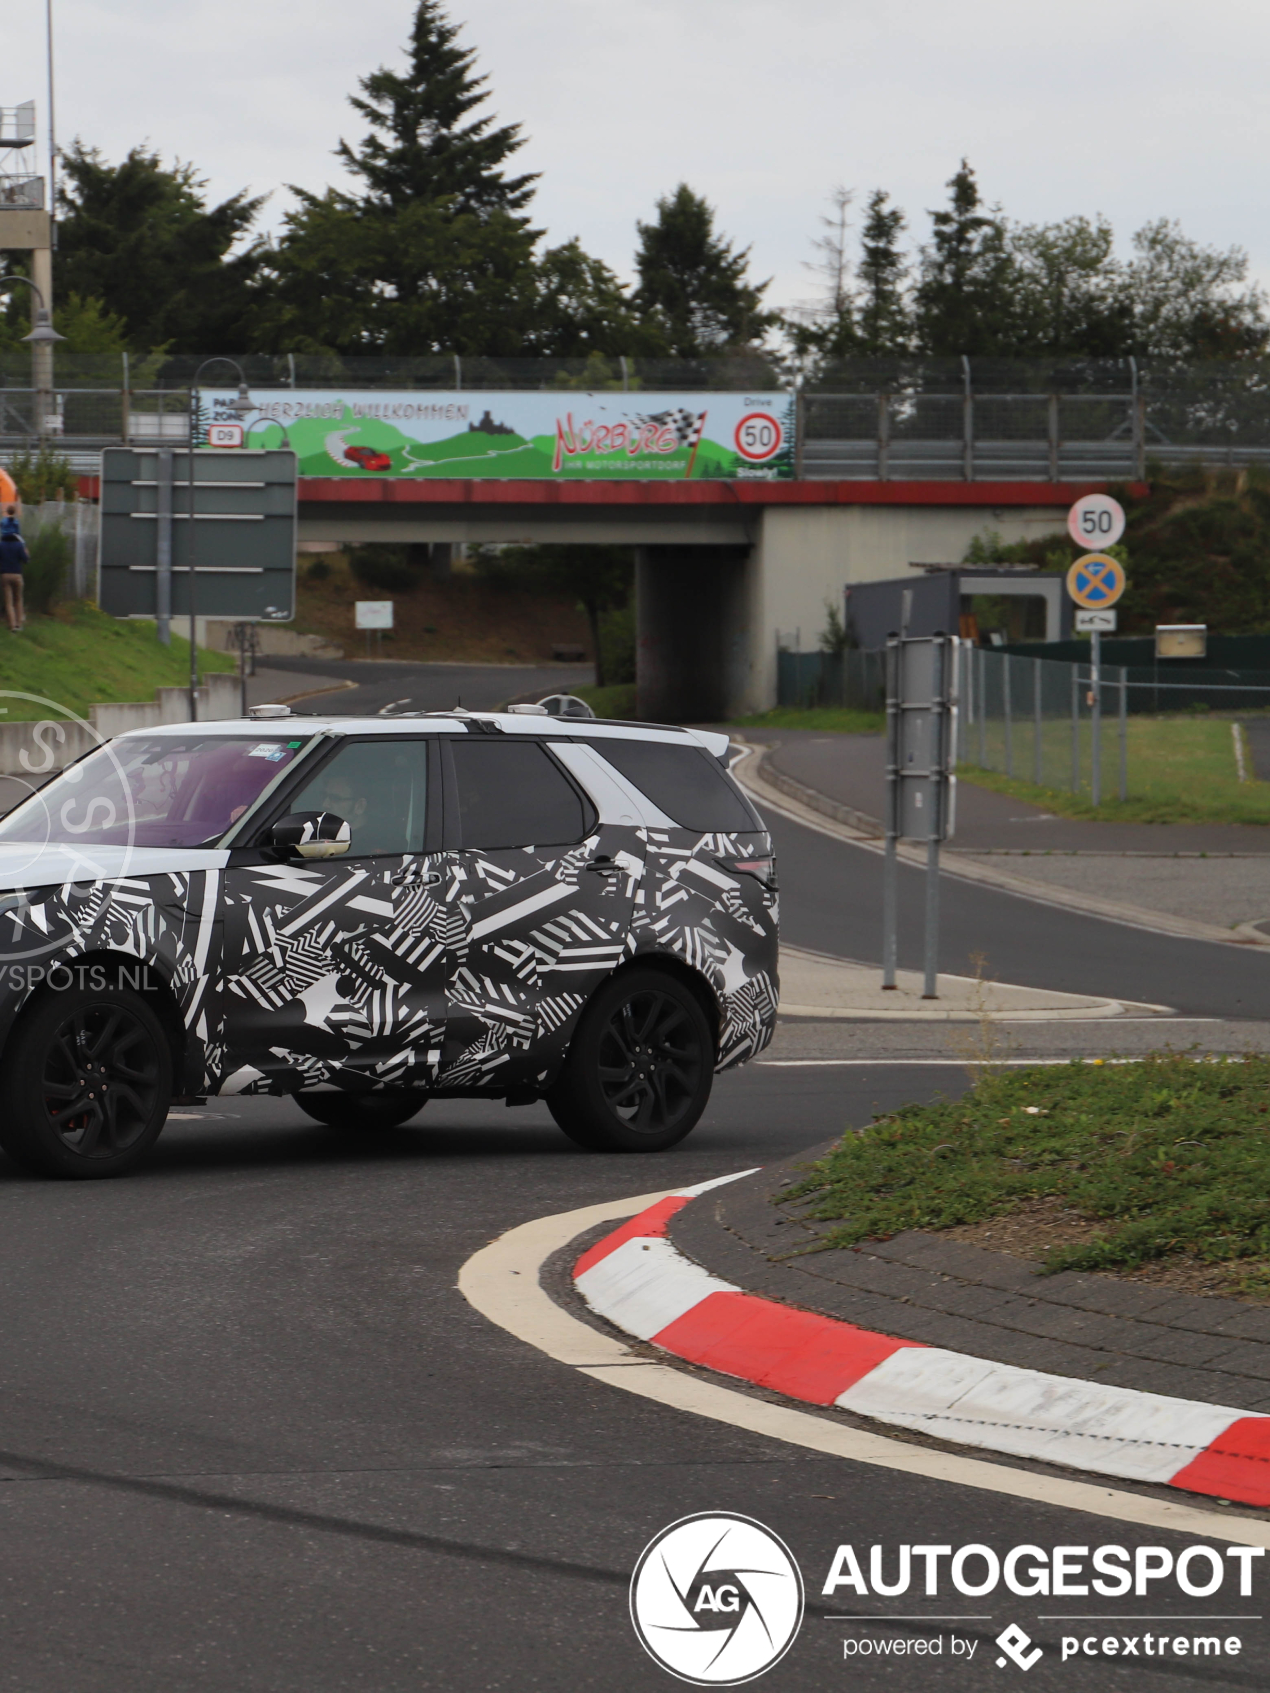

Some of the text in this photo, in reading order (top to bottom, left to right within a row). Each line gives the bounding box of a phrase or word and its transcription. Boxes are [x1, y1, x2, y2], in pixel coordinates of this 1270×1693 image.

[744, 397, 772, 407] Drive
[259, 402, 469, 420] HERZLICH WILLKOMMEN
[217, 429, 235, 441] D9
[745, 425, 772, 447] 50
[586, 460, 686, 470] MOTORSPORTDORF
[1083, 510, 1112, 534] 50
